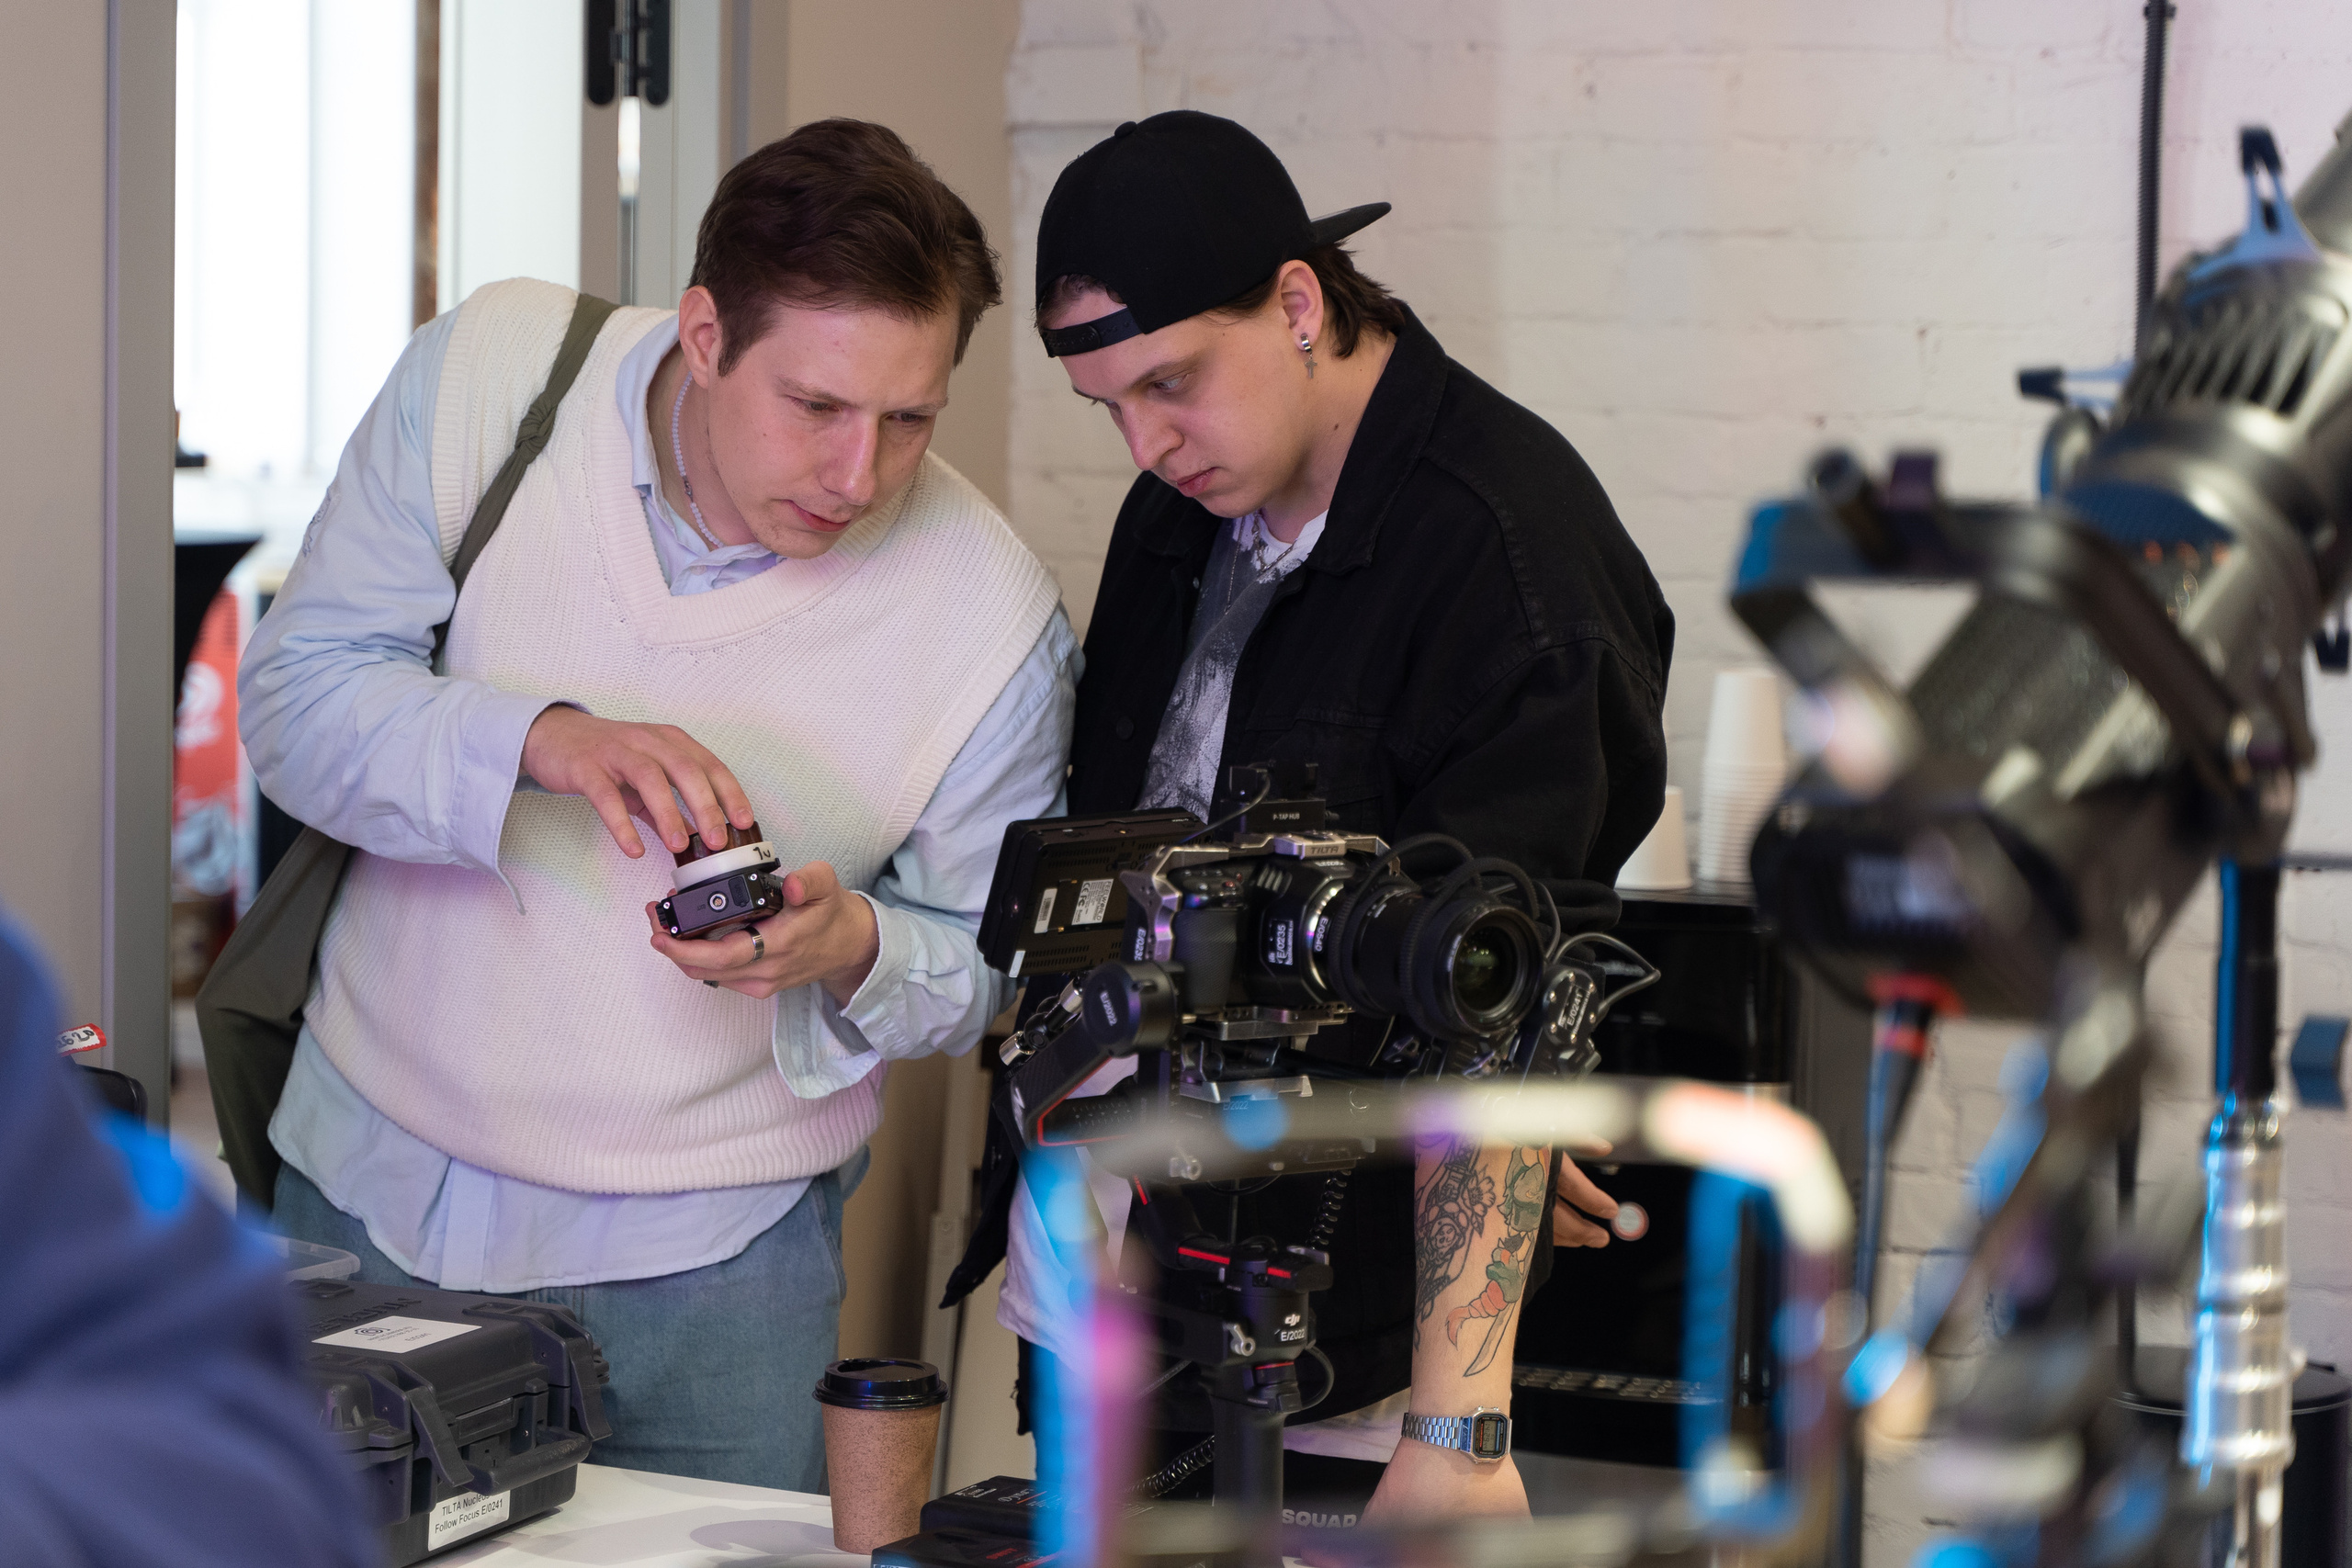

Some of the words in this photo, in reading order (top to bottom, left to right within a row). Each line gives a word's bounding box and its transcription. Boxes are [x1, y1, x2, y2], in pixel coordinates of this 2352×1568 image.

[1310, 846, 1339, 854] TILTA
[1276, 925, 1286, 960] E/0235
[1314, 916, 1329, 952] E/0540
[1100, 991, 1117, 1026] E/2022
[1567, 993, 1583, 1026] E/0241
[1223, 1101, 1249, 1111] E/2022
[1280, 1329, 1306, 1342] E/2022
[435, 1518, 458, 1534] Follow
[459, 1509, 480, 1524] Focus
[481, 1498, 503, 1515] E/0241
[442, 1501, 461, 1516] TILTA
